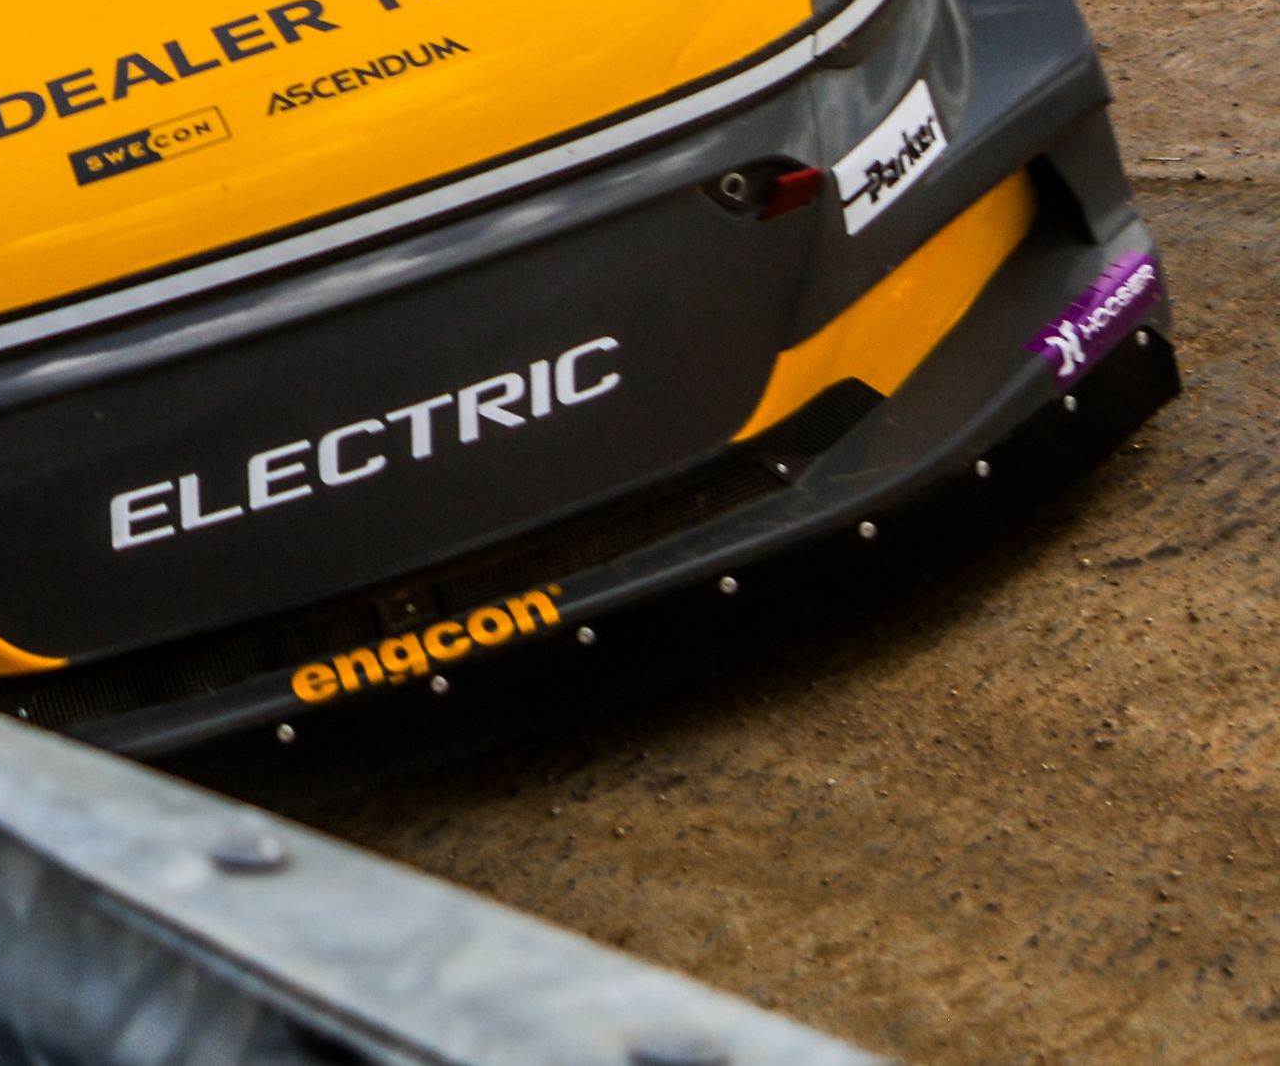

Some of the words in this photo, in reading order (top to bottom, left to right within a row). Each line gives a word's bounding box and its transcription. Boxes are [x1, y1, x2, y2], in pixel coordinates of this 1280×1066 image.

[266, 36, 470, 117] ASCENDUM
[84, 120, 213, 173] SWECON
[864, 116, 936, 204] Parker
[109, 335, 620, 551] ELECTRIC
[291, 589, 561, 703] engcon
